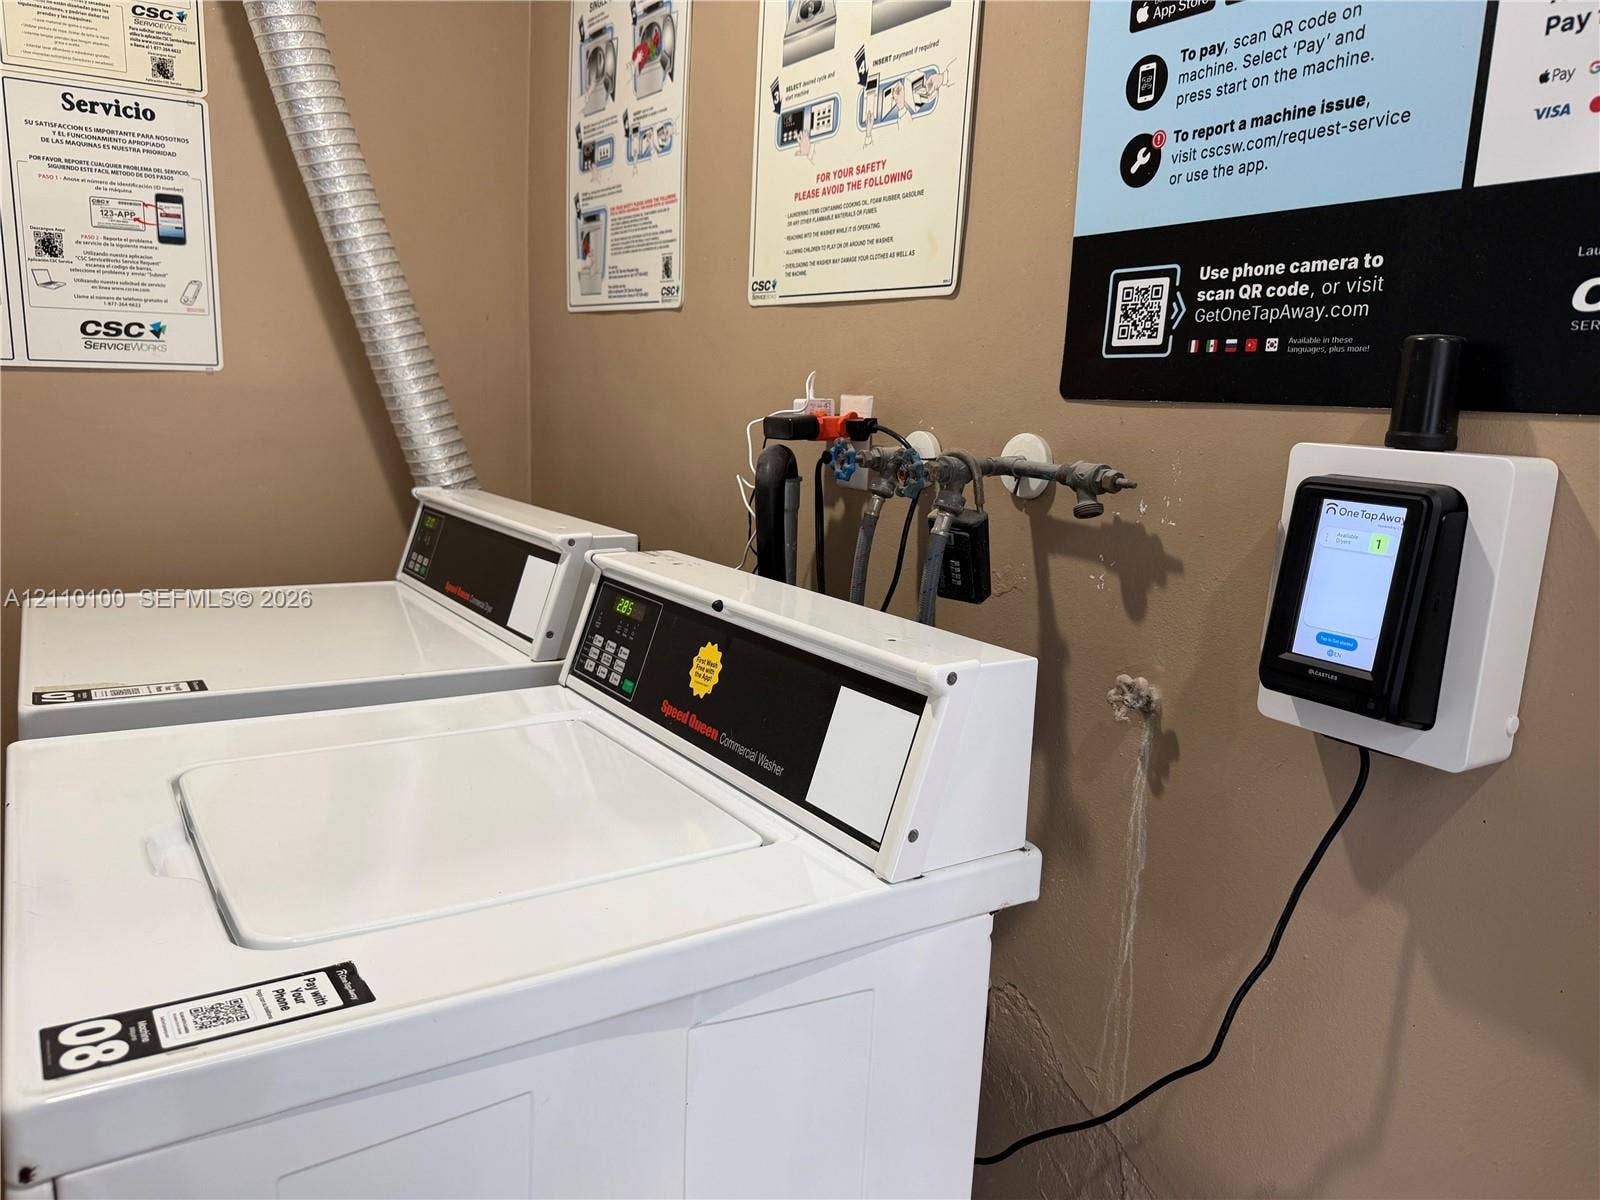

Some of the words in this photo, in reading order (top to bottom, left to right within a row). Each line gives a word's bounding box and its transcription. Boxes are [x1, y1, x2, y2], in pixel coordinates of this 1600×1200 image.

[132, 5, 174, 20] CSC
[1152, 5, 1176, 19] App
[1181, 48, 1196, 62] To
[1200, 42, 1227, 60] pay,
[1234, 31, 1266, 48] scan
[1272, 21, 1293, 38] QR
[1299, 12, 1336, 31] code
[1343, 5, 1362, 20] on
[1545, 12, 1592, 36] Pay
[873, 55, 892, 66] INSERT
[893, 49, 913, 61] payment
[919, 40, 939, 52] required
[1179, 62, 1236, 83] machine.
[1243, 46, 1287, 68] Select
[1336, 25, 1365, 45] and
[1176, 89, 1211, 108] press
[1217, 78, 1247, 96] start
[1252, 75, 1268, 88] on
[1275, 68, 1297, 83] the
[1303, 52, 1373, 76] machine.
[1552, 68, 1576, 82] Pay
[61, 92, 156, 121] Servicio
[774, 92, 780, 104] 3
[1174, 130, 1188, 143] To
[1193, 120, 1235, 140] report
[1239, 120, 1246, 130] a
[1251, 106, 1316, 127] machine
[1321, 96, 1369, 114] issue,
[1534, 103, 1570, 120] VISA
[35, 121, 83, 131] SATISFACCION
[94, 128, 135, 137] IMPORTANTE
[1172, 148, 1196, 163] visit
[1202, 112, 1410, 158] cscsw.com/request-service
[65, 140, 101, 148] MAQUINAS
[67, 133, 127, 144] FUNCIONAMIENTO
[128, 140, 165, 148] APROPIADO
[817, 172, 830, 183] FOR
[833, 167, 853, 179] YOUR
[856, 160, 886, 175] SAFETY
[1170, 174, 1182, 185] or
[1186, 170, 1208, 182] use
[1213, 165, 1234, 178] the
[1239, 160, 1267, 176] app.
[795, 189, 819, 201] PLEASE
[822, 184, 844, 196] AVOID
[847, 180, 861, 191] THE
[864, 170, 912, 187] FOLLOWING
[100, 209, 136, 219] 123-APP
[1200, 267, 1229, 280] Use
[1233, 263, 1285, 280] phone
[1290, 258, 1358, 273] camera
[1364, 254, 1383, 268] to
[661, 286, 676, 296] CSC
[752, 281, 771, 292] CSC
[1198, 289, 1234, 301] scan
[1239, 284, 1262, 299] QR
[1266, 282, 1313, 297] code,
[1322, 282, 1340, 294] or
[1347, 276, 1383, 292] visit
[1195, 304, 1370, 324] GetOneTapAway.com
[80, 320, 145, 338] CSC
[1376, 539, 1381, 549] 1
[696, 656, 706, 665] First
[706, 659, 718, 669] Wash
[696, 664, 705, 672] Free
[661, 700, 690, 724] Speed
[689, 714, 719, 741] Queen
[720, 732, 758, 761] Commercial
[758, 752, 784, 776] Washer
[272, 988, 290, 1012] Phone
[290, 987, 306, 1004] Your
[304, 977, 318, 991] Pay
[311, 991, 328, 1007] with
[58, 1019, 130, 1070] 08
